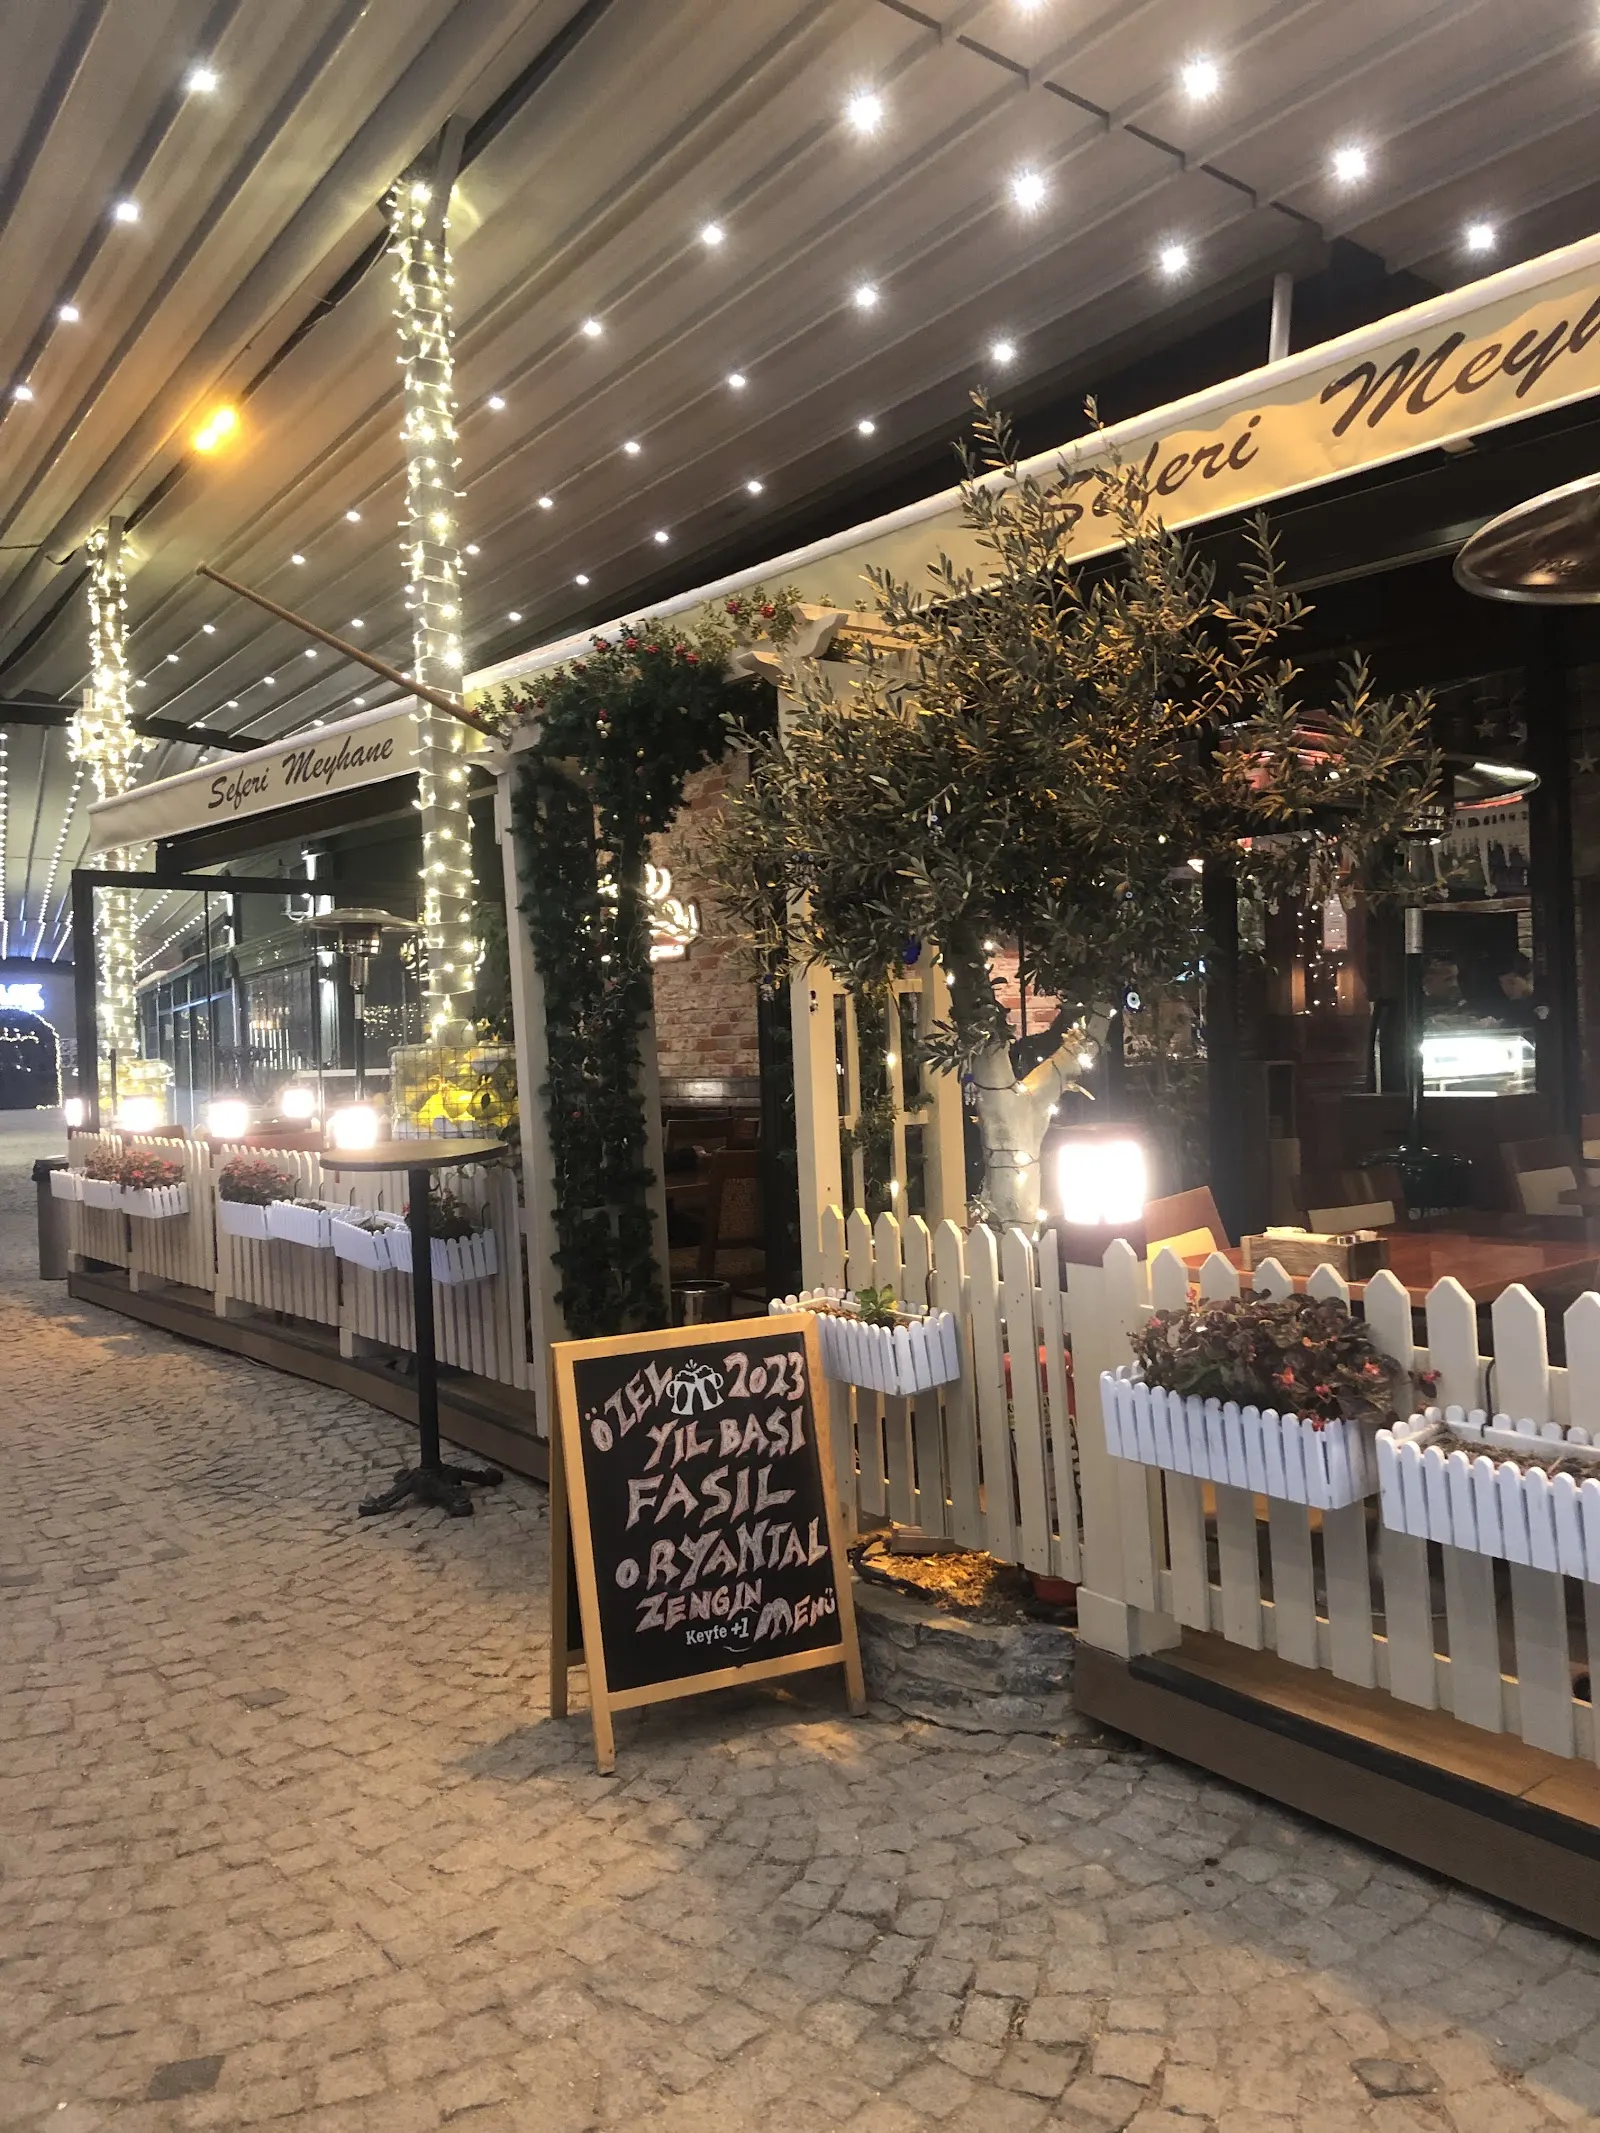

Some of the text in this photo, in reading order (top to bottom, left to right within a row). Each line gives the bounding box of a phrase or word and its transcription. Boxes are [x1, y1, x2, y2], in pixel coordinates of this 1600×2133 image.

[208, 735, 394, 810] Seferi Meyhane
[723, 1351, 805, 1400] 2023
[625, 1464, 796, 1530] FASIL
[615, 1516, 829, 1591] ORYANTAL
[685, 1616, 750, 1646] Keyfe +1
